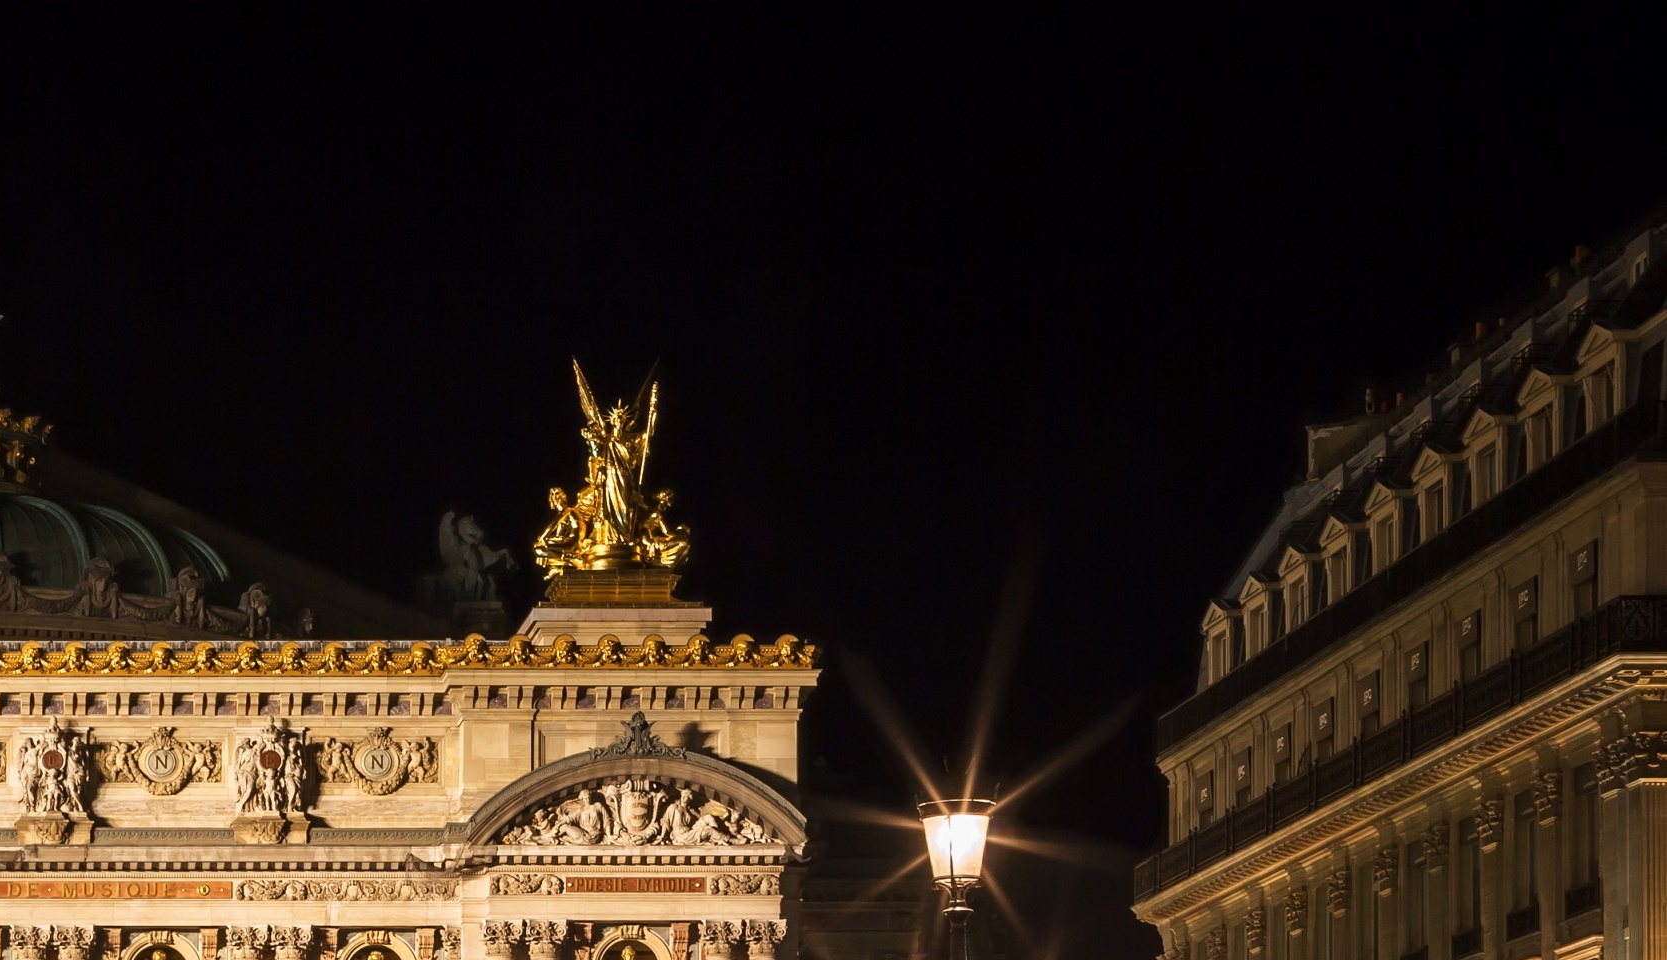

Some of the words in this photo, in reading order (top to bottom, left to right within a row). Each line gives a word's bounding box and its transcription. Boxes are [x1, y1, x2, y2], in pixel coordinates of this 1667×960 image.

[155, 755, 168, 769] N
[371, 755, 384, 769] N
[6, 882, 41, 898] DE
[61, 882, 176, 898] MUSIQUE
[574, 878, 627, 892] POESIE
[636, 878, 696, 892] LYRIQUE
